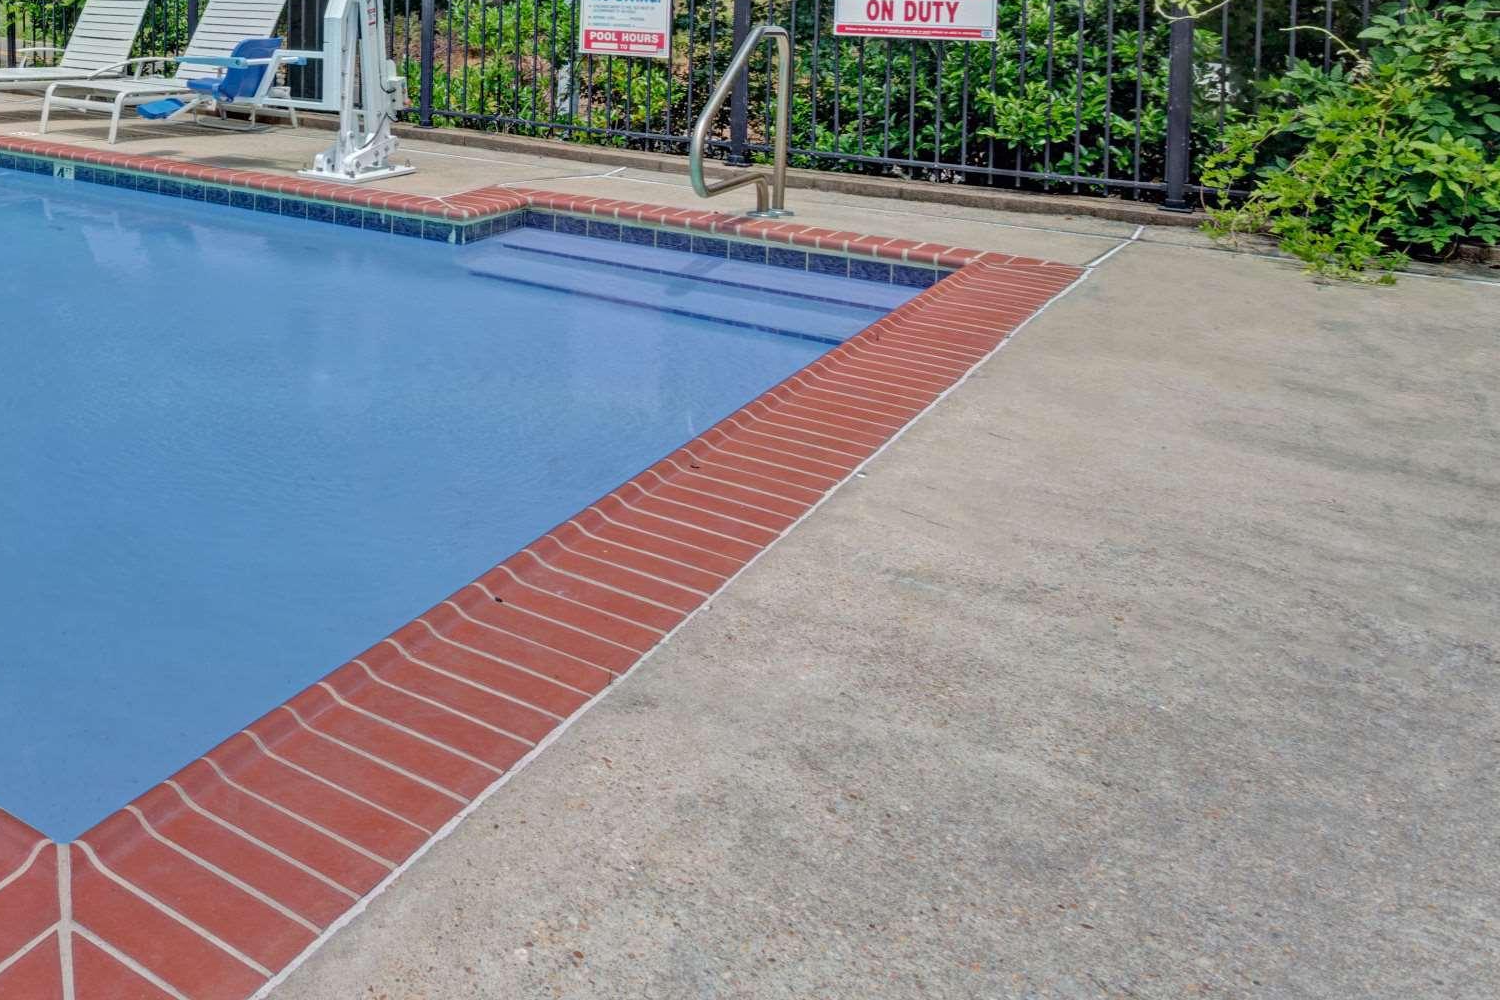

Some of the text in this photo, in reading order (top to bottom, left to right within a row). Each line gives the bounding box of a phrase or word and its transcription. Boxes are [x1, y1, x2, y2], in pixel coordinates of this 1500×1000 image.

[866, 0, 960, 23] ON DUTY
[589, 31, 659, 43] POOL HOURS
